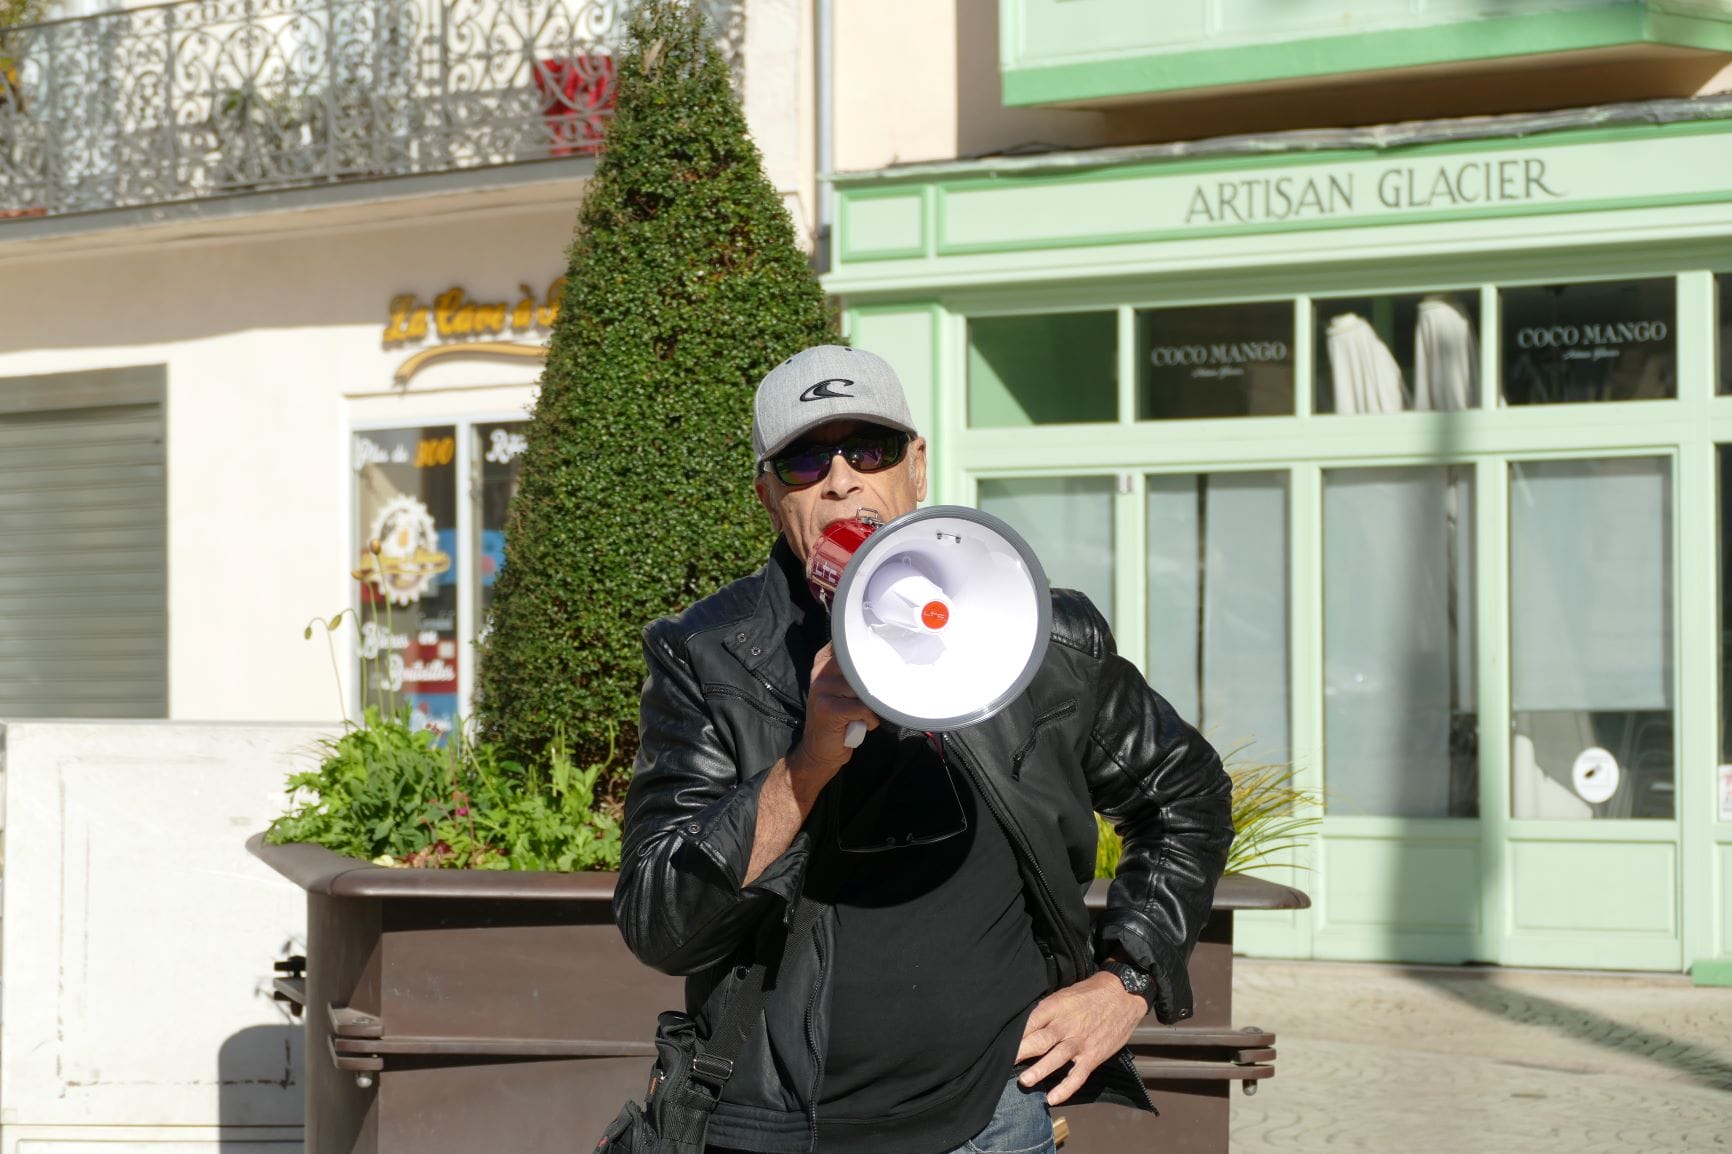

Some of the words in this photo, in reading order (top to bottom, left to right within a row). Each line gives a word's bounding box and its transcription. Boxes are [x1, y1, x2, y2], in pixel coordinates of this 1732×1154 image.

[1184, 172, 1356, 224] ARTISAN
[1377, 158, 1569, 209] GLACIER
[1517, 325, 1580, 349] COCO
[1581, 320, 1668, 345] MANGO
[1151, 344, 1208, 367] COCO
[1208, 341, 1287, 364] MANGO
